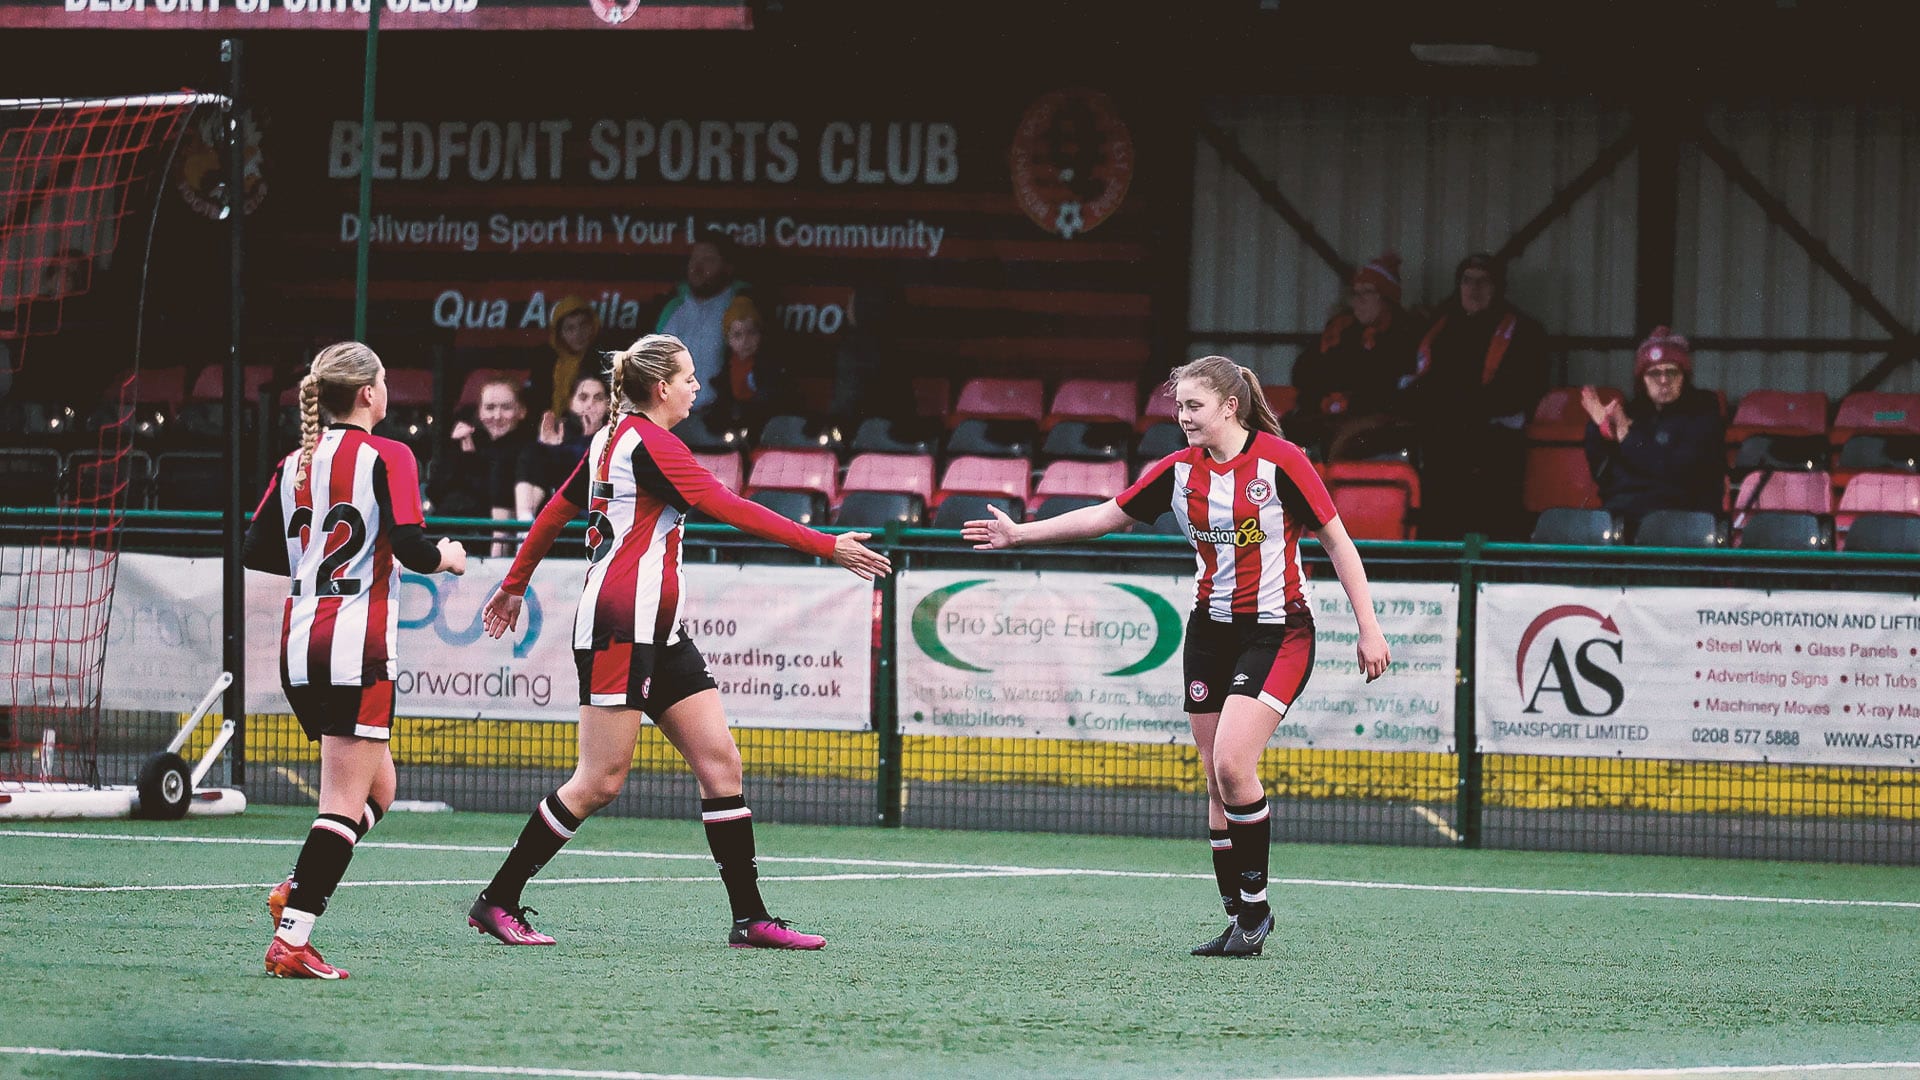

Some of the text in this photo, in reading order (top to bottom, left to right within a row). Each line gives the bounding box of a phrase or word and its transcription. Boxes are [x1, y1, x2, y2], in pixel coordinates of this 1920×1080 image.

[327, 119, 573, 181] BEDFONT
[588, 119, 799, 184] SPORTS
[819, 121, 960, 185] CLUB
[489, 213, 569, 251] Sport
[577, 214, 603, 243] In
[612, 214, 678, 245] Your
[775, 215, 945, 257] Community
[433, 290, 508, 329] Qua
[519, 291, 640, 329] Aila
[1188, 518, 1268, 547] PensionBee
[682, 618, 738, 637] 51600
[945, 611, 1152, 646] Pro Stage Europe
[1696, 610, 1920, 630] TRANSPORTATION AND LIFTI
[1706, 638, 1899, 659] Steel Work Glass Panels
[702, 649, 844, 671] warding.co.uk
[395, 665, 552, 707] orwarding
[1522, 636, 1625, 717] AS
[1706, 668, 1918, 689] Advertising Signs Hot Tubs
[716, 678, 842, 700] arding.co.uk
[1706, 698, 1780, 716] Machinery
[1784, 701, 1831, 716] Moves
[1856, 702, 1895, 720] X-ray
[932, 707, 1026, 728] Exhibitions
[1373, 719, 1441, 744] Staging
[1491, 720, 1650, 741] TRANSPORT LIMITED
[1691, 727, 1729, 744] 0208
[1734, 728, 1761, 745] 577
[1765, 729, 1800, 746] 5888
